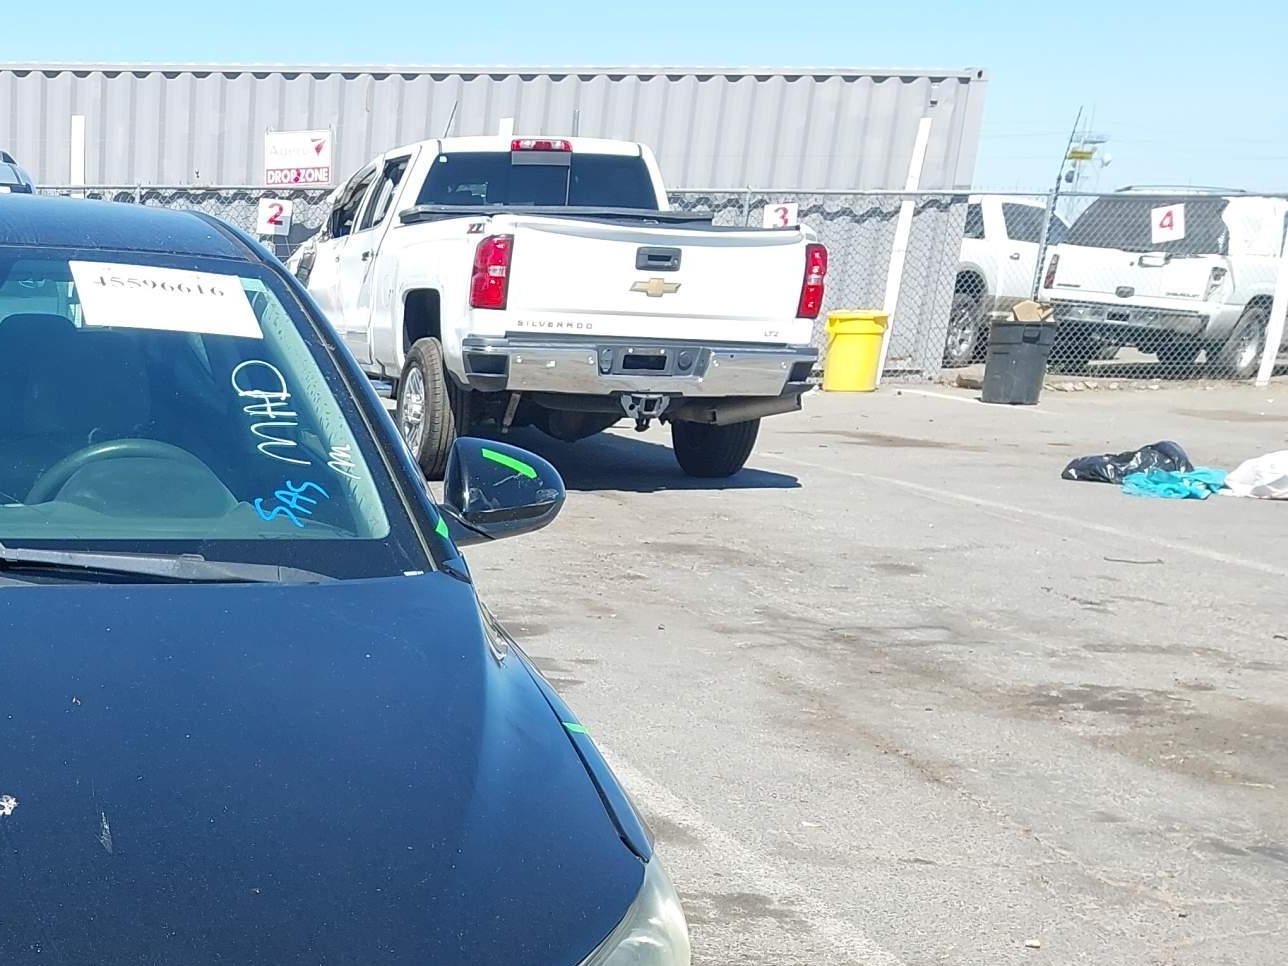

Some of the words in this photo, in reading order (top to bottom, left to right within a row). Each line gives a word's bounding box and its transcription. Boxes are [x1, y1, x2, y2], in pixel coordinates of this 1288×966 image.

[267, 169, 297, 184] DROP
[299, 168, 329, 182] ZONE
[267, 203, 283, 226] 2
[774, 206, 789, 228] 3
[1159, 210, 1174, 231] 4
[517, 320, 593, 330] SILVERADO
